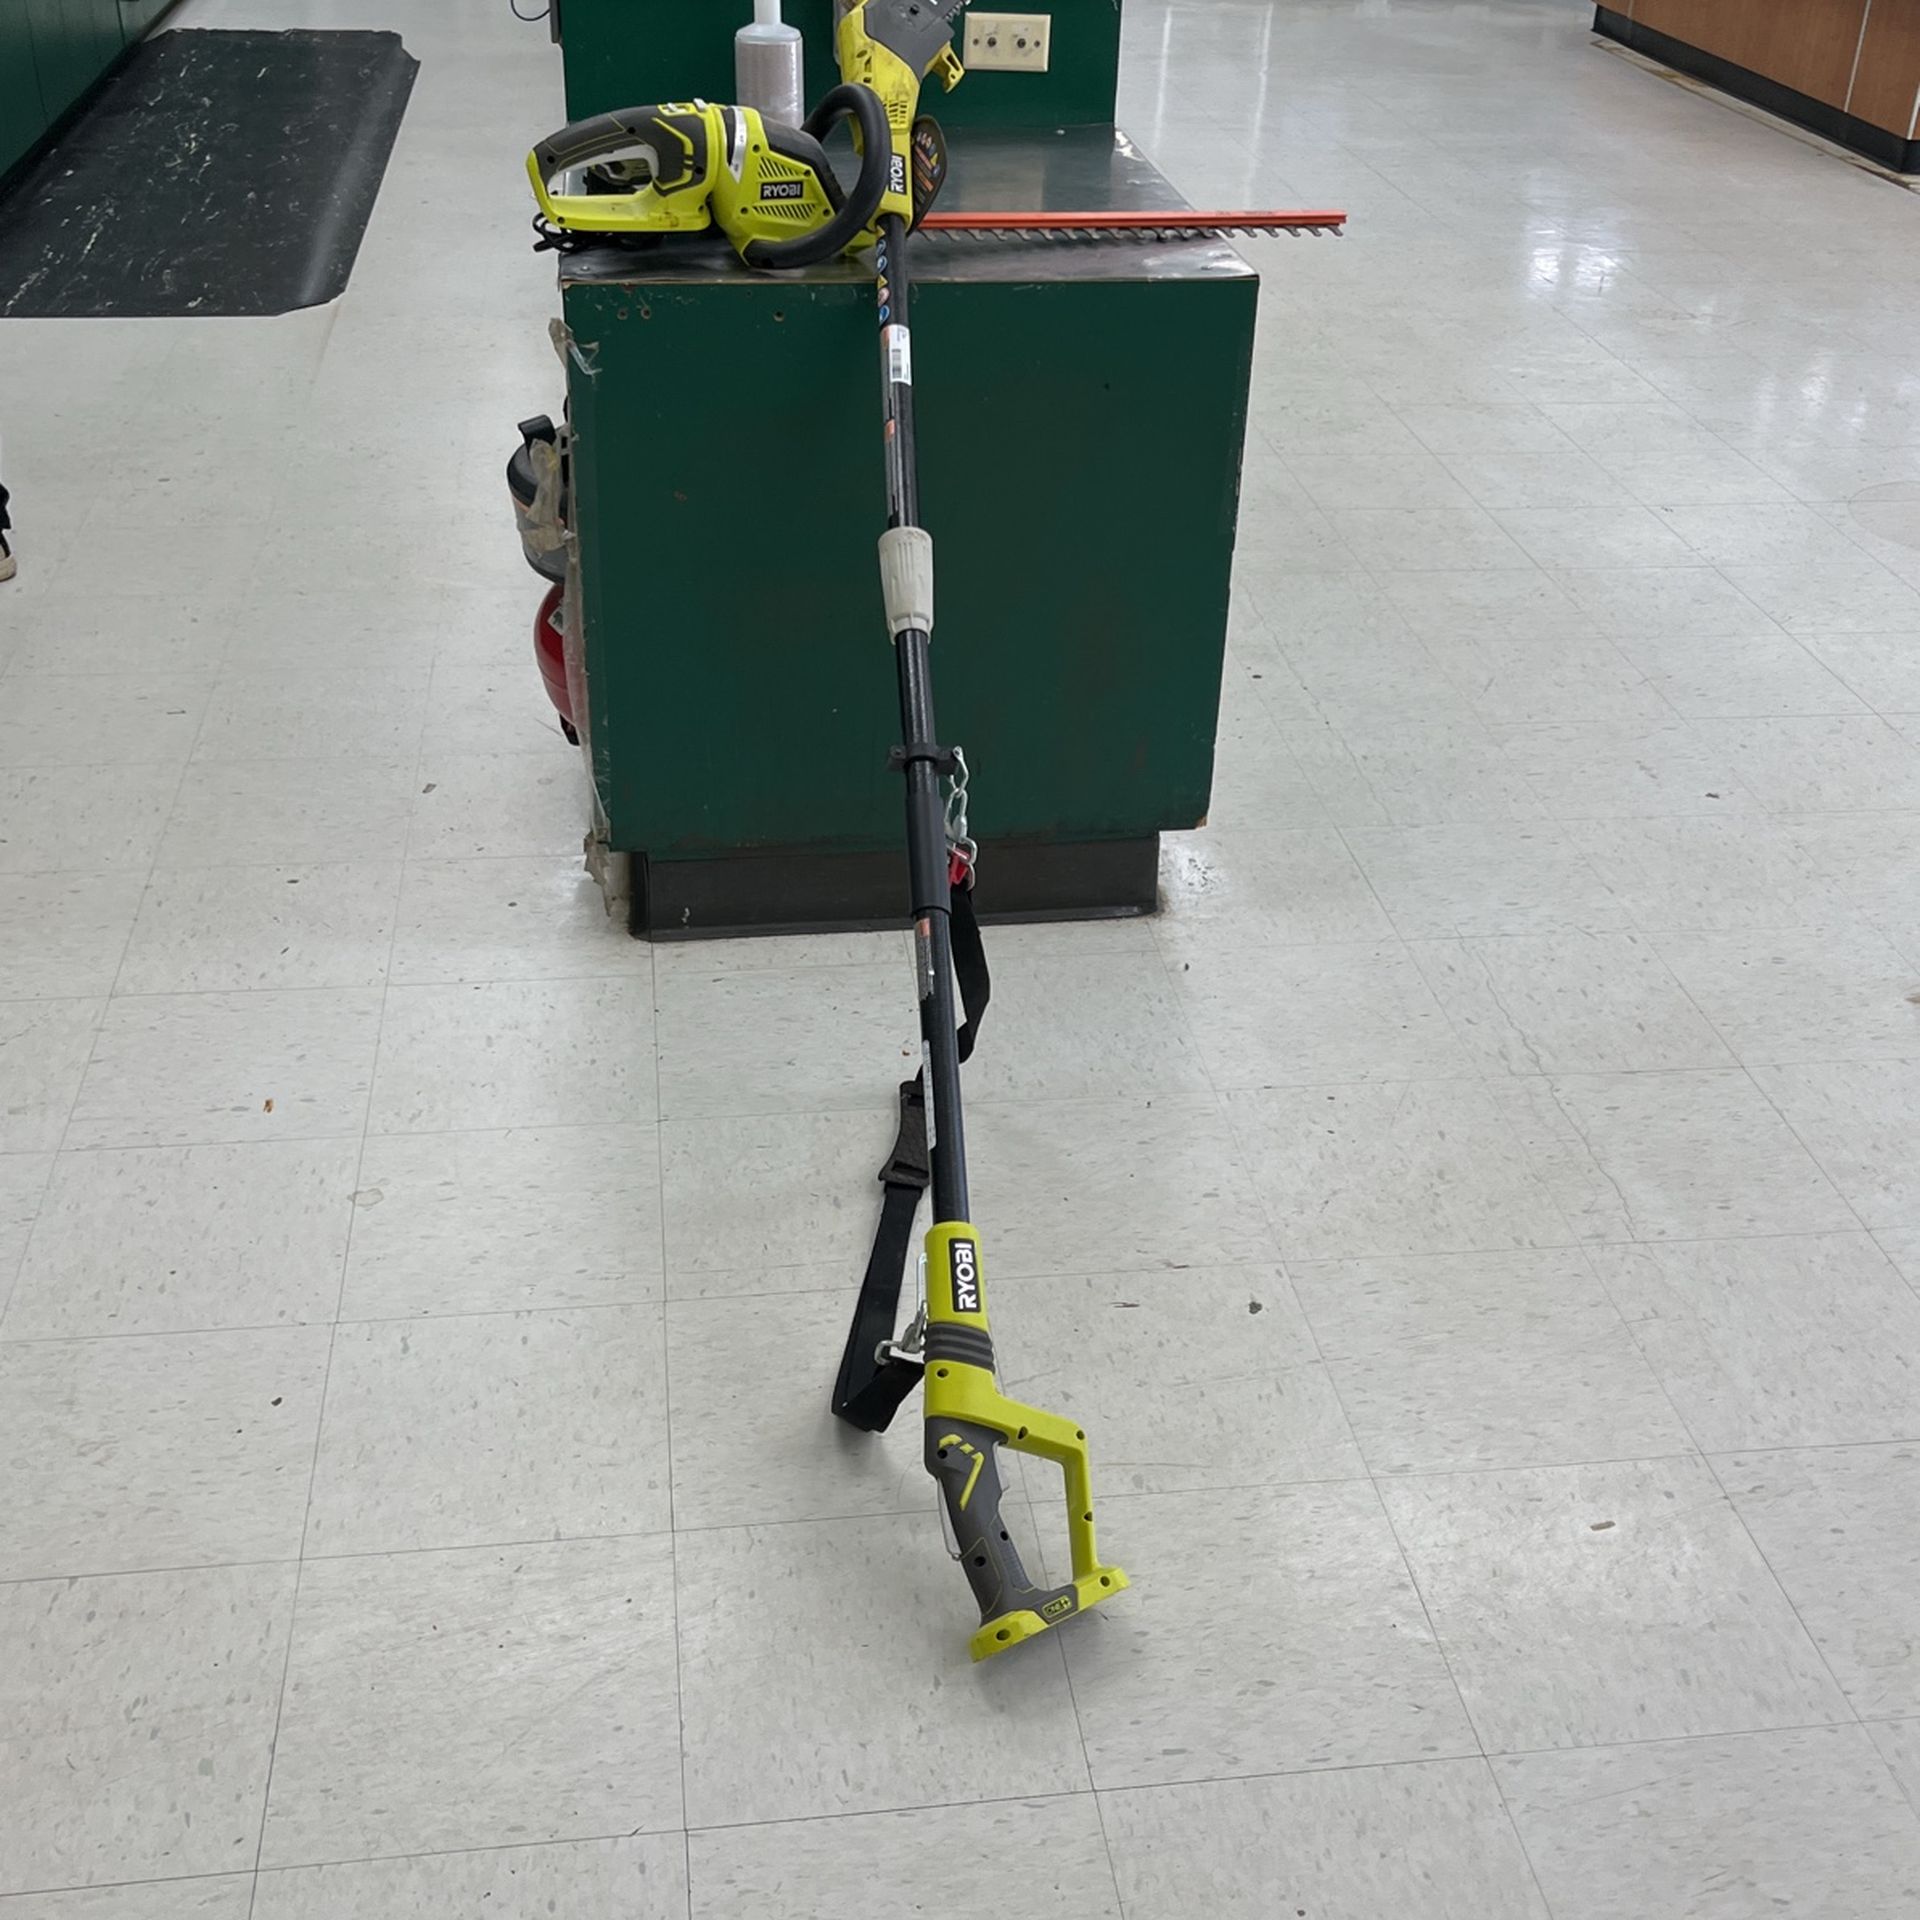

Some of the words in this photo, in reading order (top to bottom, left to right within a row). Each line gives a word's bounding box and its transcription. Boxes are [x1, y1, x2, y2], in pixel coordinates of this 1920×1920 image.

[763, 184, 801, 198] RYOBI
[890, 155, 904, 193] RYOBI
[954, 1243, 977, 1309] RYOBI
